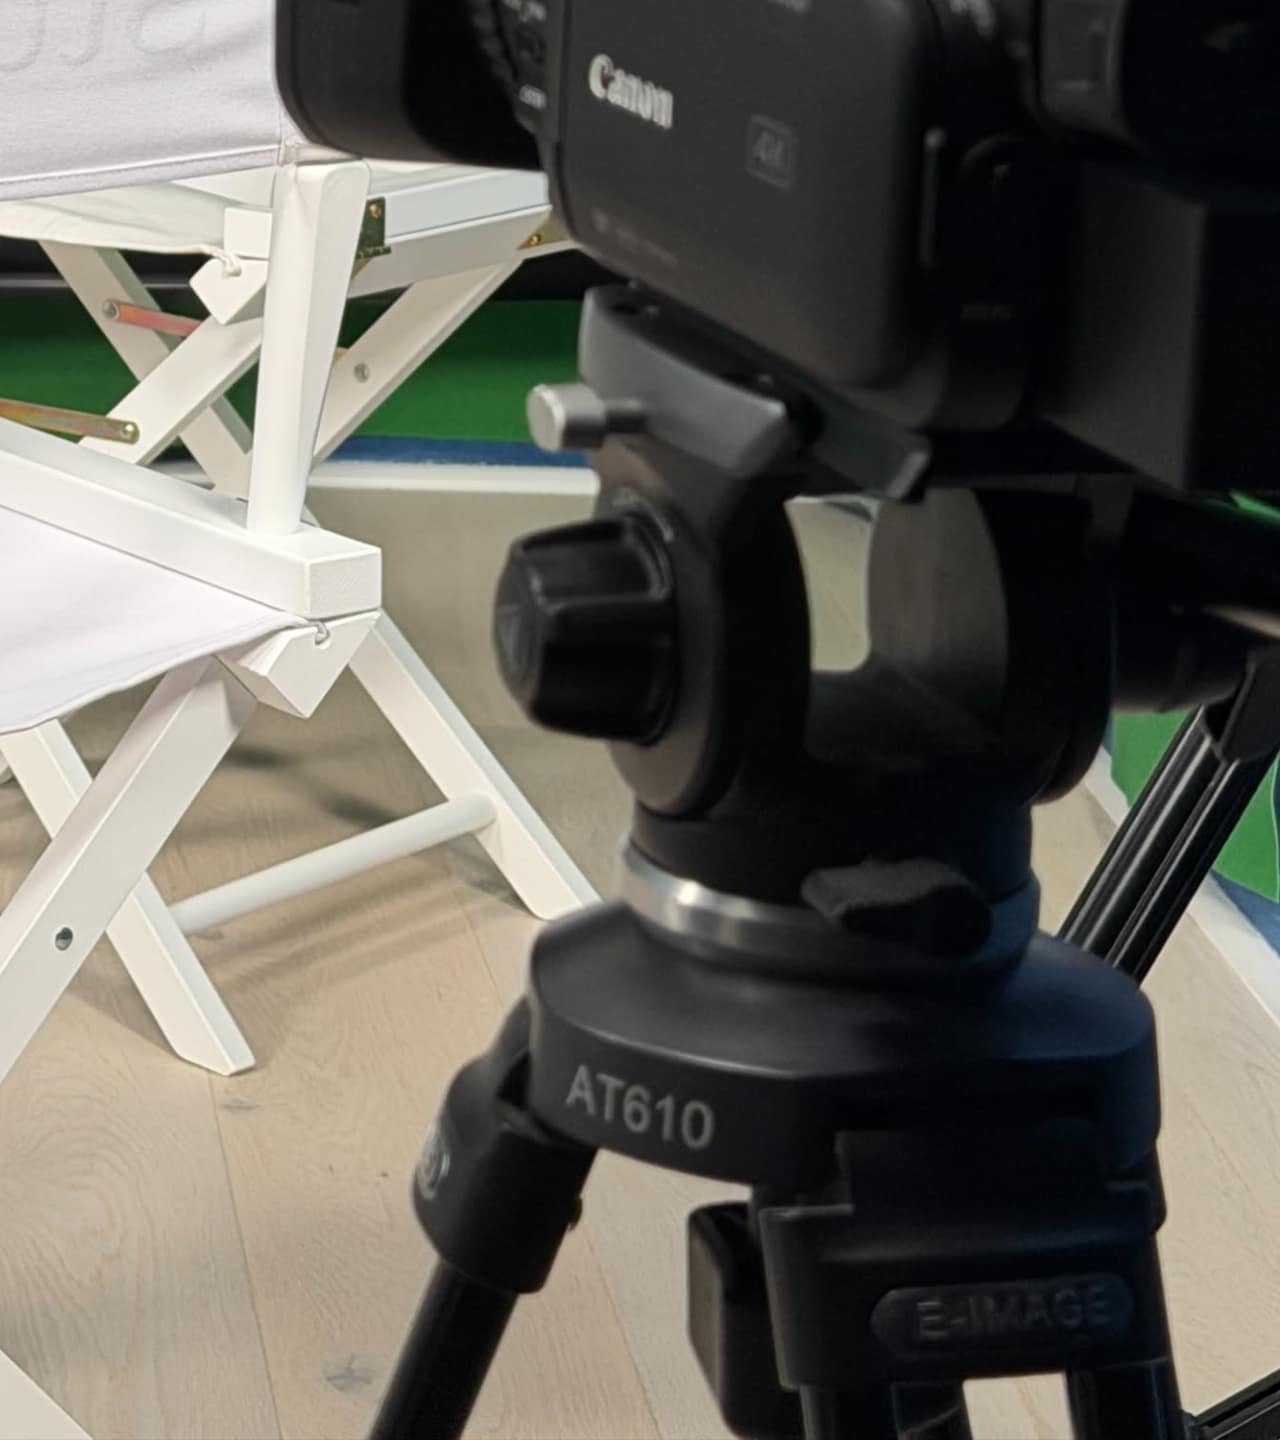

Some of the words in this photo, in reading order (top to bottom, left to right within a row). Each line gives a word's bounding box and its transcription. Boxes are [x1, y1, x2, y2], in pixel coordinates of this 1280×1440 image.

[589, 53, 674, 130] Canon
[564, 1063, 716, 1151] AT610
[916, 1283, 1112, 1340] E-IMAGE
